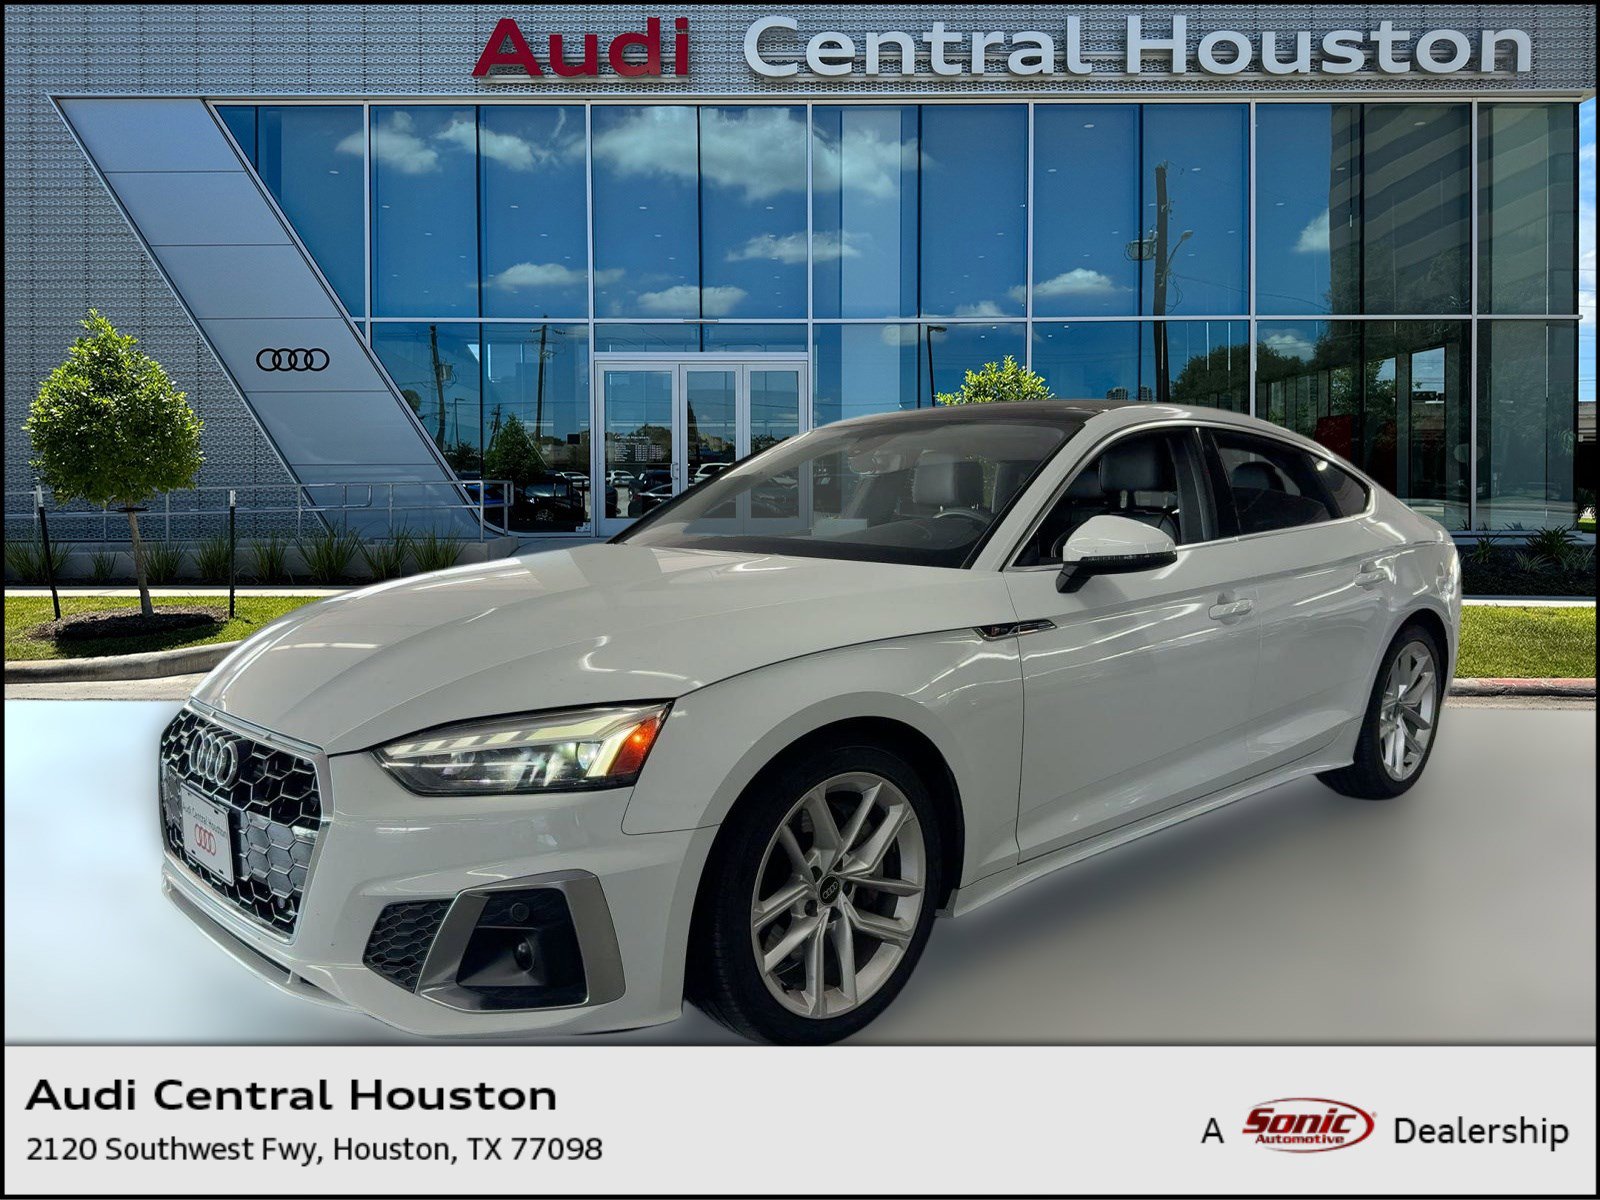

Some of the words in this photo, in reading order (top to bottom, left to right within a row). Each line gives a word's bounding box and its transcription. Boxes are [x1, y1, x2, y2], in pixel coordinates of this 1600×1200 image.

[471, 16, 689, 77] Audi
[743, 15, 1093, 75] Central
[1126, 14, 1532, 75] Houston
